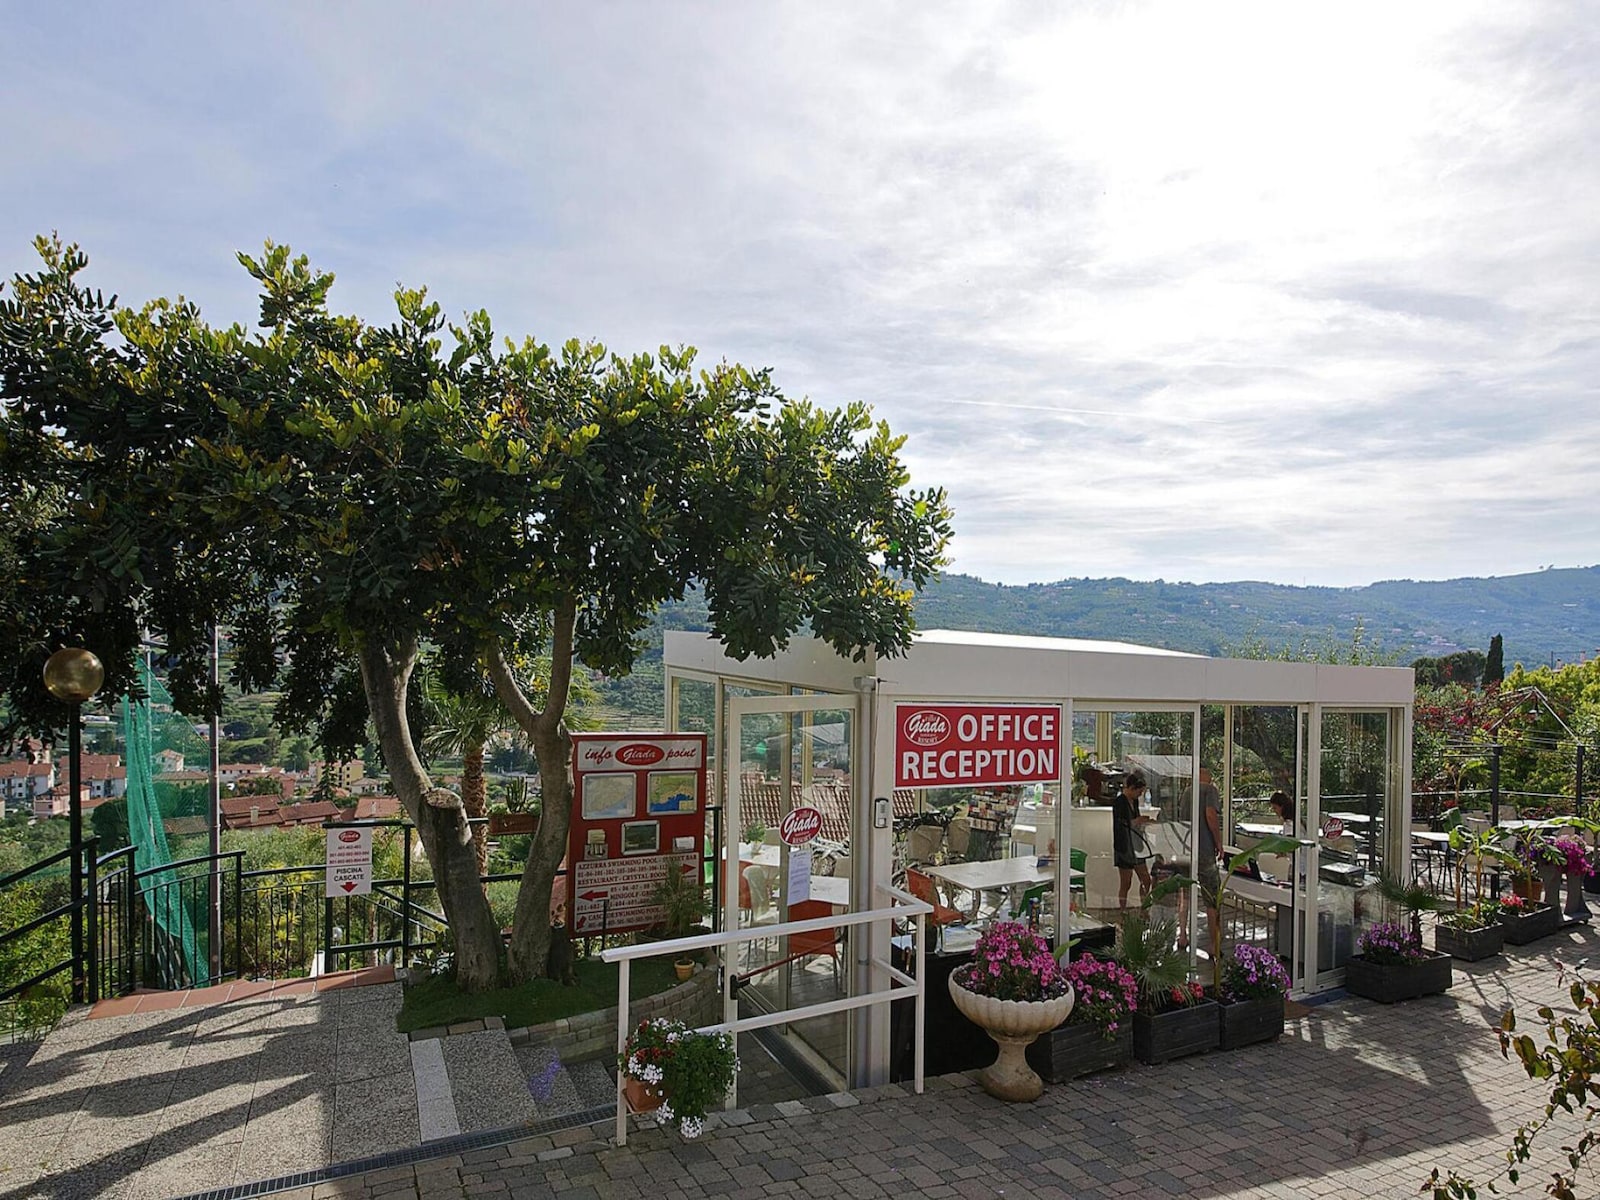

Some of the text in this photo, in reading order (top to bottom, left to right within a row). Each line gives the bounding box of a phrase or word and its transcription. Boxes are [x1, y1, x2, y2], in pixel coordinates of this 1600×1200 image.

[909, 714, 946, 738] Giada
[957, 714, 1054, 742] OFFICE
[585, 746, 697, 765] info Giada point
[902, 748, 1054, 780] RECEPTION
[784, 810, 819, 841] Giada
[578, 861, 607, 870] AZZURRA
[608, 858, 642, 868] SWIMMING
[642, 857, 657, 865] POOL
[333, 874, 365, 882] CASCATE
[577, 876, 618, 886] RESTAURANT
[622, 873, 650, 882] CRYSTAL
